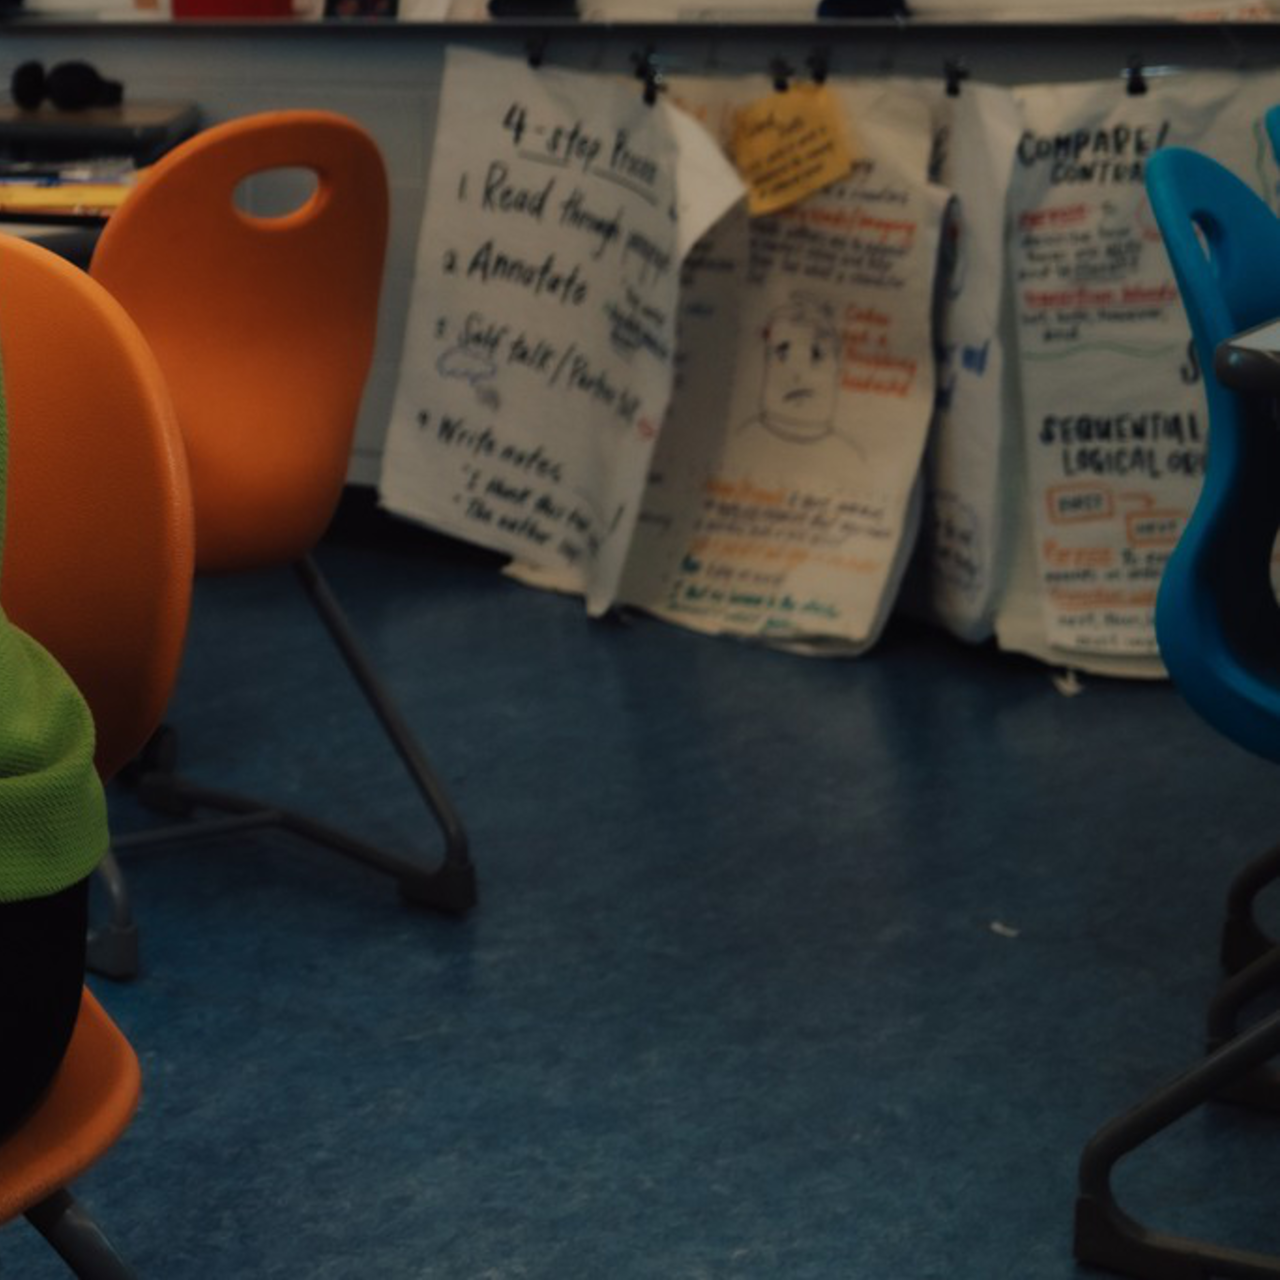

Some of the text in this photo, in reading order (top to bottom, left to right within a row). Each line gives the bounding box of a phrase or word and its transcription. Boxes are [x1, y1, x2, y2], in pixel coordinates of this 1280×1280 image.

[481, 158, 557, 225] Read
[466, 237, 590, 308] Annotate
[437, 414, 498, 461] Write
[1039, 412, 1200, 446] SEQUENTIAL
[1061, 445, 1161, 479] LOGICAL
